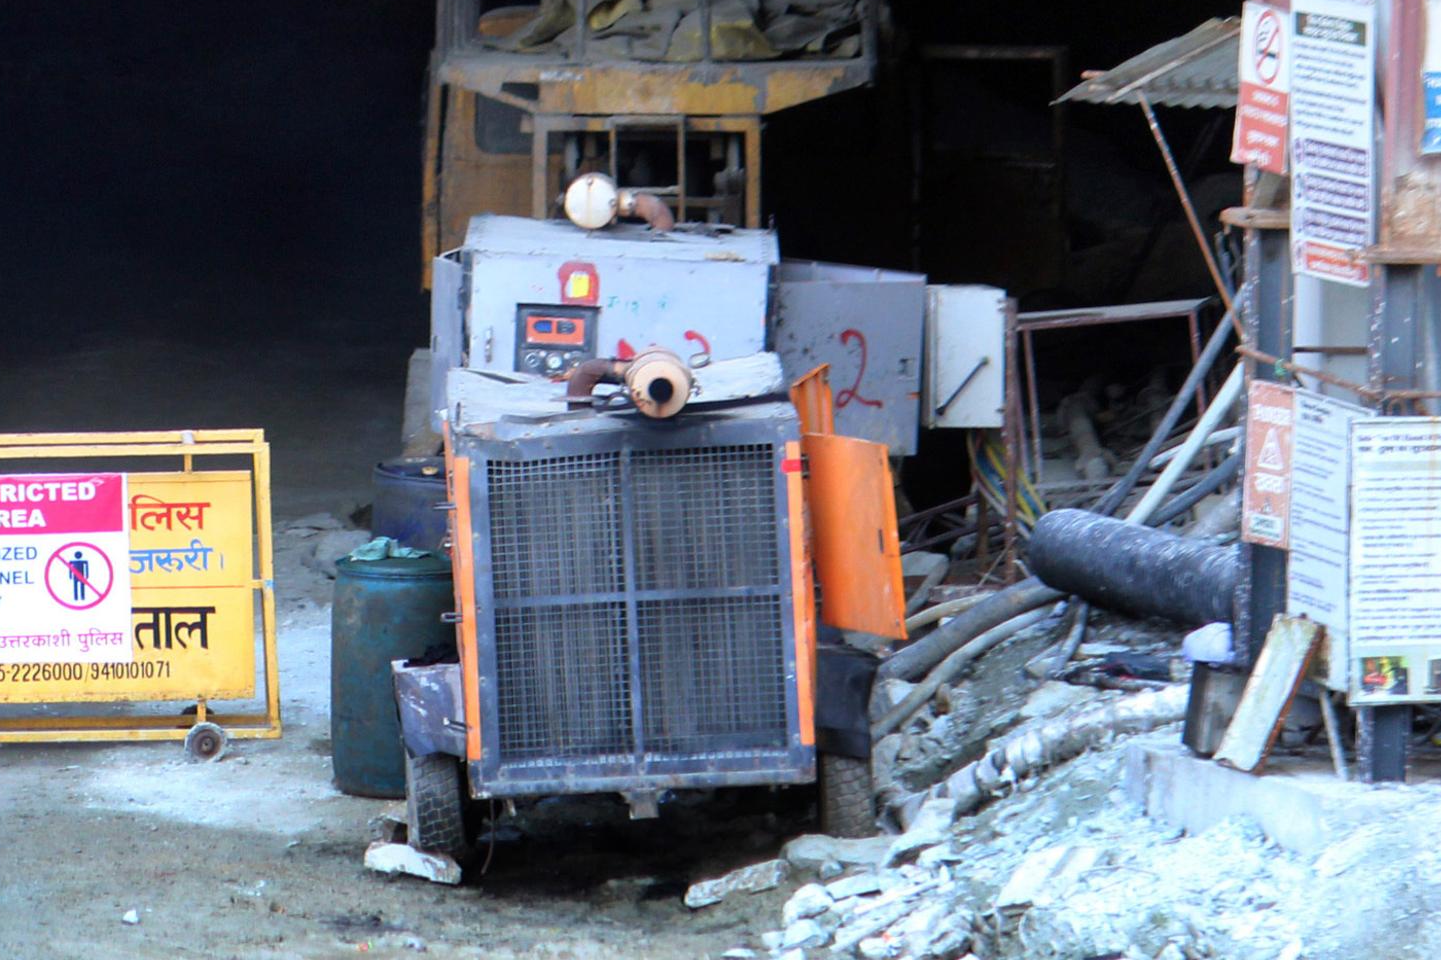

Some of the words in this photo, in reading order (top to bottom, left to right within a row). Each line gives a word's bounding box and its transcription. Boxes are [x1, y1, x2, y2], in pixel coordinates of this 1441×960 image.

[836, 329, 883, 409] 2
[128, 494, 211, 531] लिस
[77, 628, 123, 652] पुलिस
